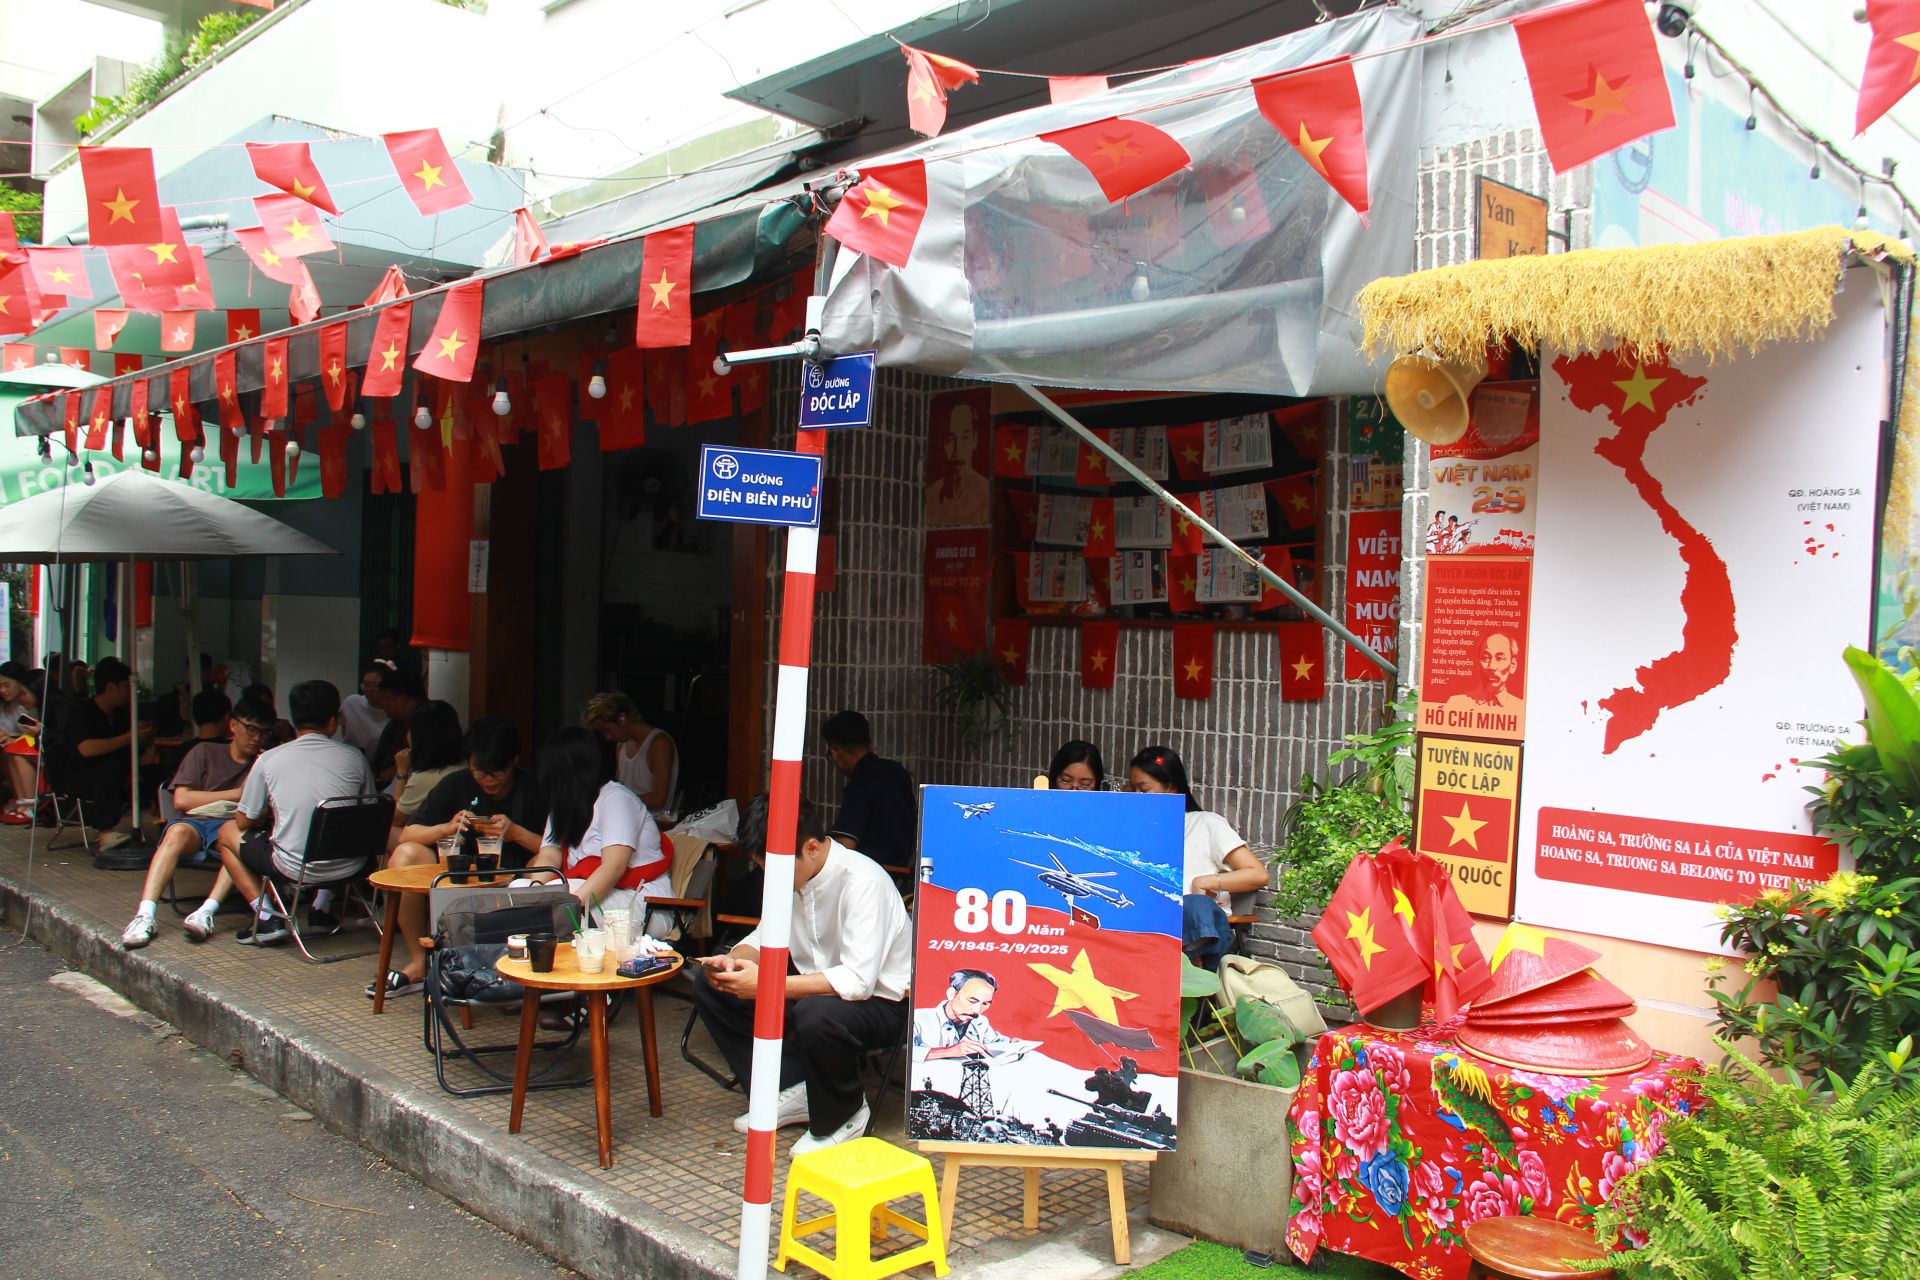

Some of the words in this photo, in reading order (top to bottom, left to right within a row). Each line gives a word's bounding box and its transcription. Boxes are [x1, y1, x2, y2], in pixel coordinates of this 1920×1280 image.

[1486, 194, 1514, 226] Yan
[825, 377, 849, 389] ĐƯỜNG
[811, 392, 836, 415] ĐỘC
[838, 390, 860, 412] LẬP
[742, 473, 783, 486] ĐƯỜNG
[1434, 463, 1478, 486] VIỆT
[1482, 464, 1532, 482] NAM
[707, 488, 741, 505] ĐIỆN
[746, 491, 778, 506] BIÊN
[782, 494, 812, 509] PHỦ
[1824, 502, 1850, 511] NAM)
[1358, 529, 1400, 560] VIỆT
[1356, 570, 1400, 587] NAM
[1425, 705, 1444, 725] HỒ
[1448, 708, 1474, 728] CHÍ
[1477, 712, 1517, 731] MINH
[1427, 747, 1469, 766] TUYÊN
[1473, 751, 1513, 771] NGÔN
[1437, 769, 1467, 789] ĐỘC
[1471, 772, 1501, 793] LẬP
[1552, 824, 1594, 842] HOÀNG
[1598, 831, 1616, 847] SA,
[1619, 833, 1672, 852] TRƯỜNG
[1675, 839, 1690, 854] SA
[1694, 839, 1712, 857] LÀ
[1715, 840, 1743, 861] CỦA
[1746, 847, 1780, 867] VIỆT
[1782, 853, 1814, 870] NAM
[1458, 864, 1503, 887] QUỐC
[1540, 844, 1582, 862] HOANG
[1585, 850, 1603, 866] SA,
[1606, 853, 1658, 872] TRUONG
[1660, 859, 1676, 873] SA
[1680, 863, 1734, 881] BELONG
[1736, 870, 1755, 885] TO
[1758, 873, 1791, 889] VIET
[954, 887, 1027, 935] 80
[1027, 924, 1065, 936] Năm
[928, 940, 1068, 955] 2/9/1945-2/9/2025
